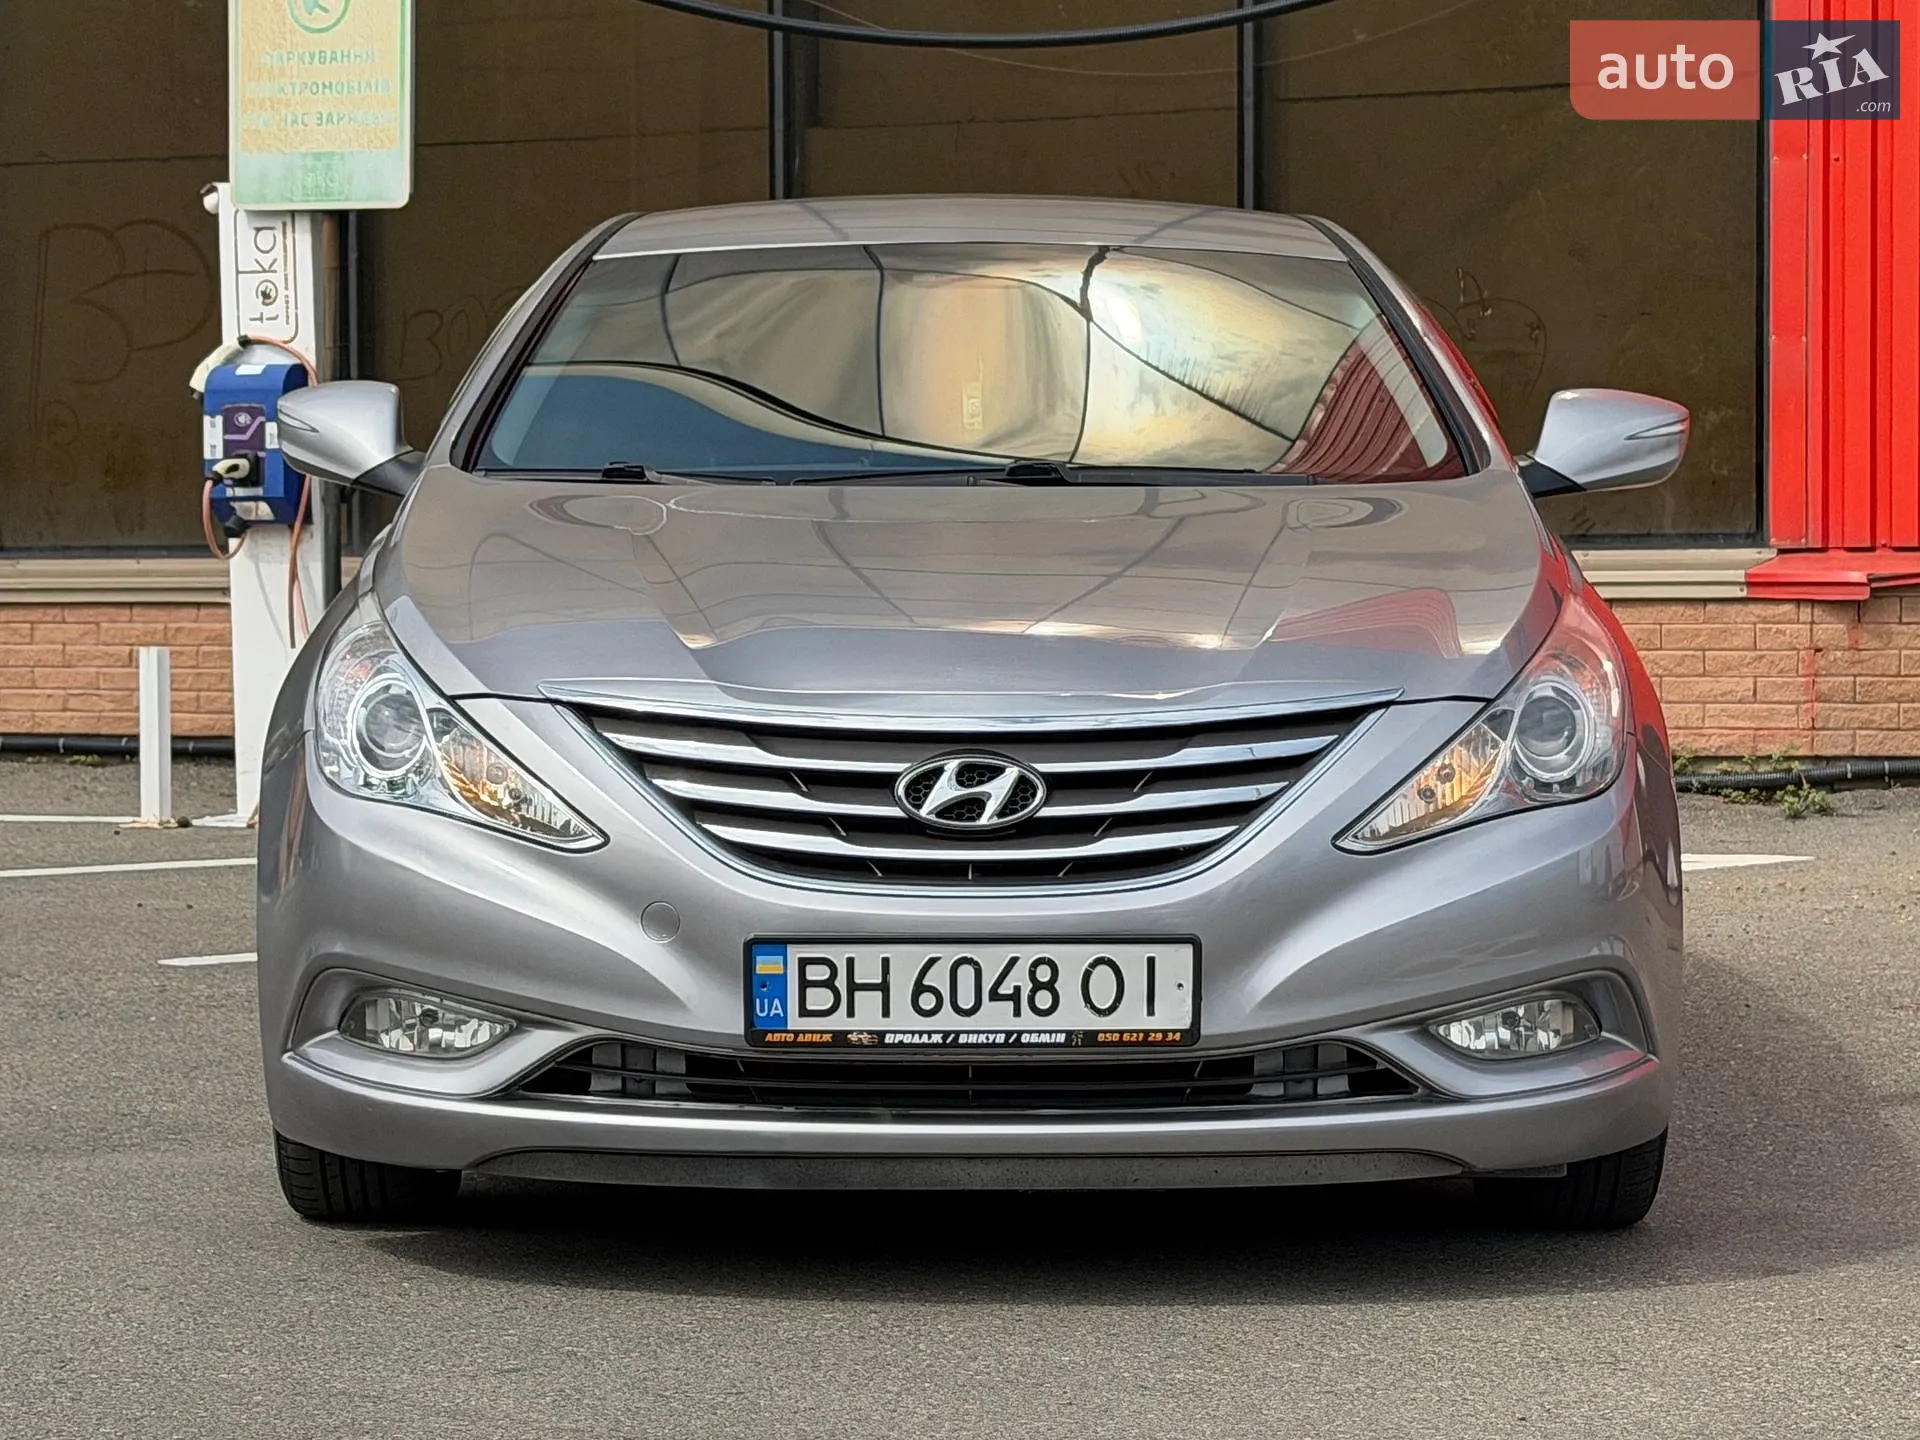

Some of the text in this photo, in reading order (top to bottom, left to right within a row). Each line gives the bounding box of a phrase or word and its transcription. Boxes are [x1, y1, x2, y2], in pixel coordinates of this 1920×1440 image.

[247, 78, 391, 97] КТРОМОБІЛІ
[797, 955, 1156, 1019] BH 6048 OI
[756, 998, 784, 1017] UA
[765, 1032, 795, 1042] АВТО
[884, 1032, 944, 1044] ПРОДАЖ
[958, 1032, 1005, 1044] ВИКУП
[1020, 1032, 1067, 1044] ОБМІН
[1097, 1032, 1121, 1042] 050
[1166, 1031, 1181, 1042] 34
